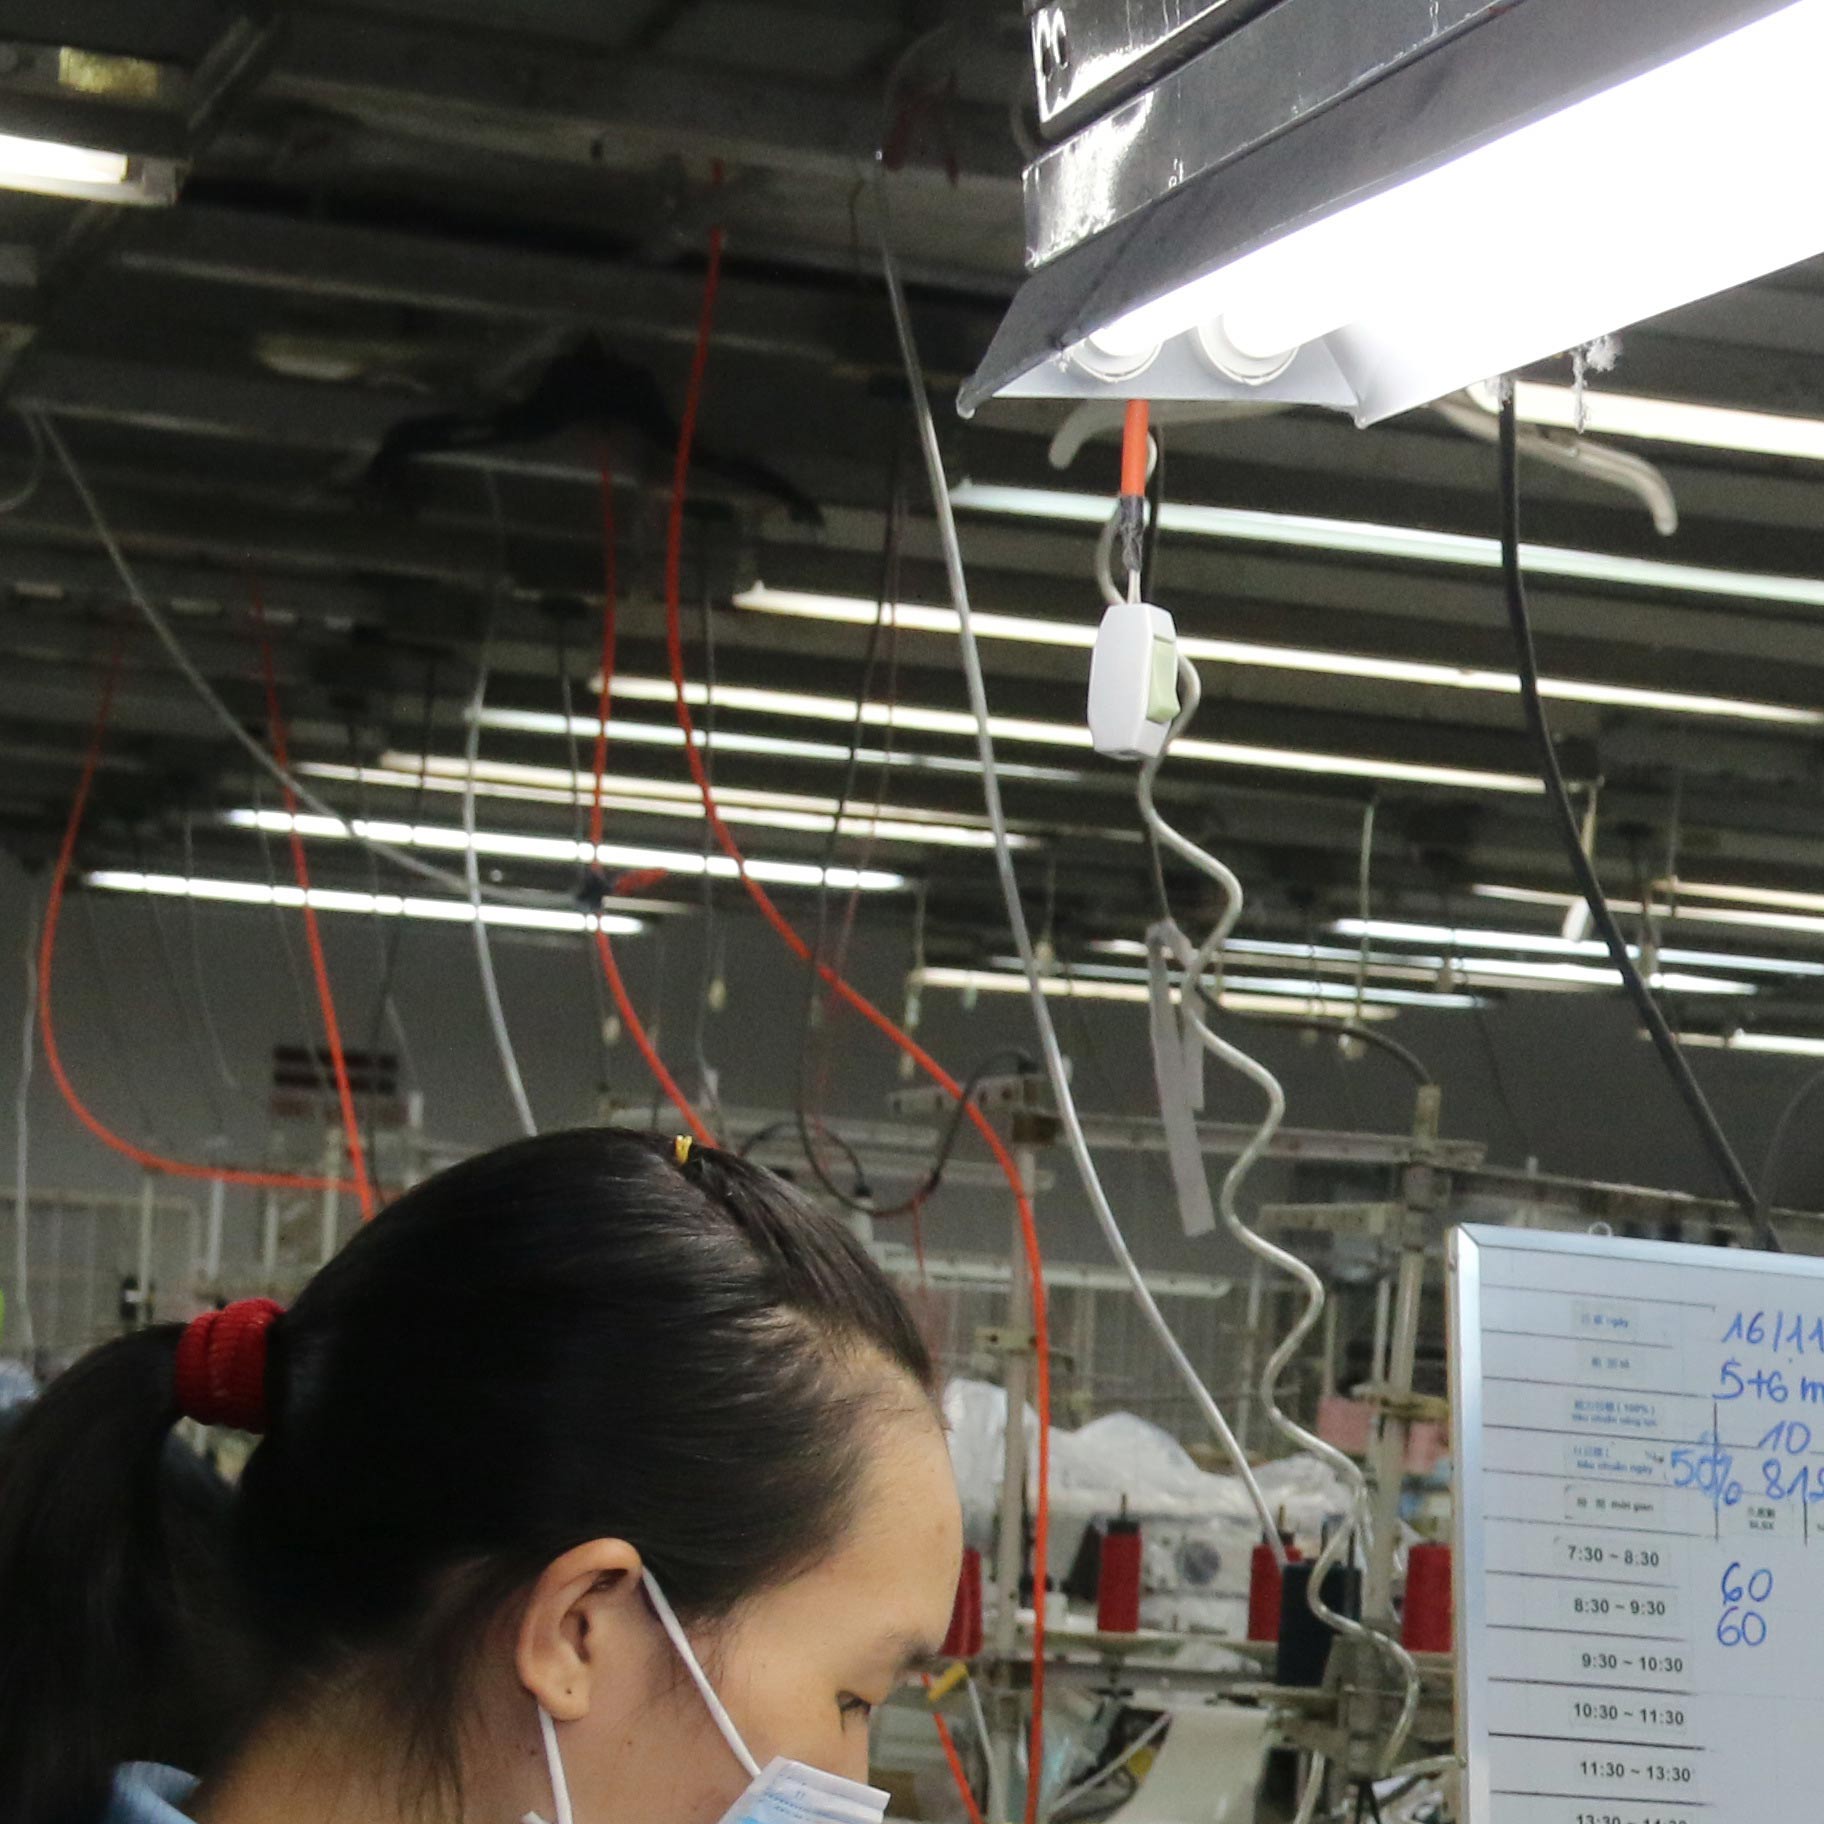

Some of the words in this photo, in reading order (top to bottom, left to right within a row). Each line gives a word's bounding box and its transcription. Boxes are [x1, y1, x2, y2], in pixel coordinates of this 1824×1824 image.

[1712, 1358, 1789, 1403] 5+6
[1759, 1423, 1812, 1455] 10
[1567, 1544, 1604, 1564] 7:30
[1624, 1549, 1660, 1568] 8:30
[1721, 1561, 1774, 1602] 60
[1574, 1597, 1610, 1616] 8:30
[1629, 1599, 1666, 1618] 9:30
[1717, 1606, 1767, 1647] 60
[1581, 1652, 1618, 1672] 9:30
[1640, 1654, 1684, 1674] 10:30
[1574, 1702, 1618, 1722] 10:30
[1640, 1707, 1685, 1727] 11:30
[1579, 1761, 1625, 1780] 11:30
[1647, 1765, 1692, 1784] 13:30
